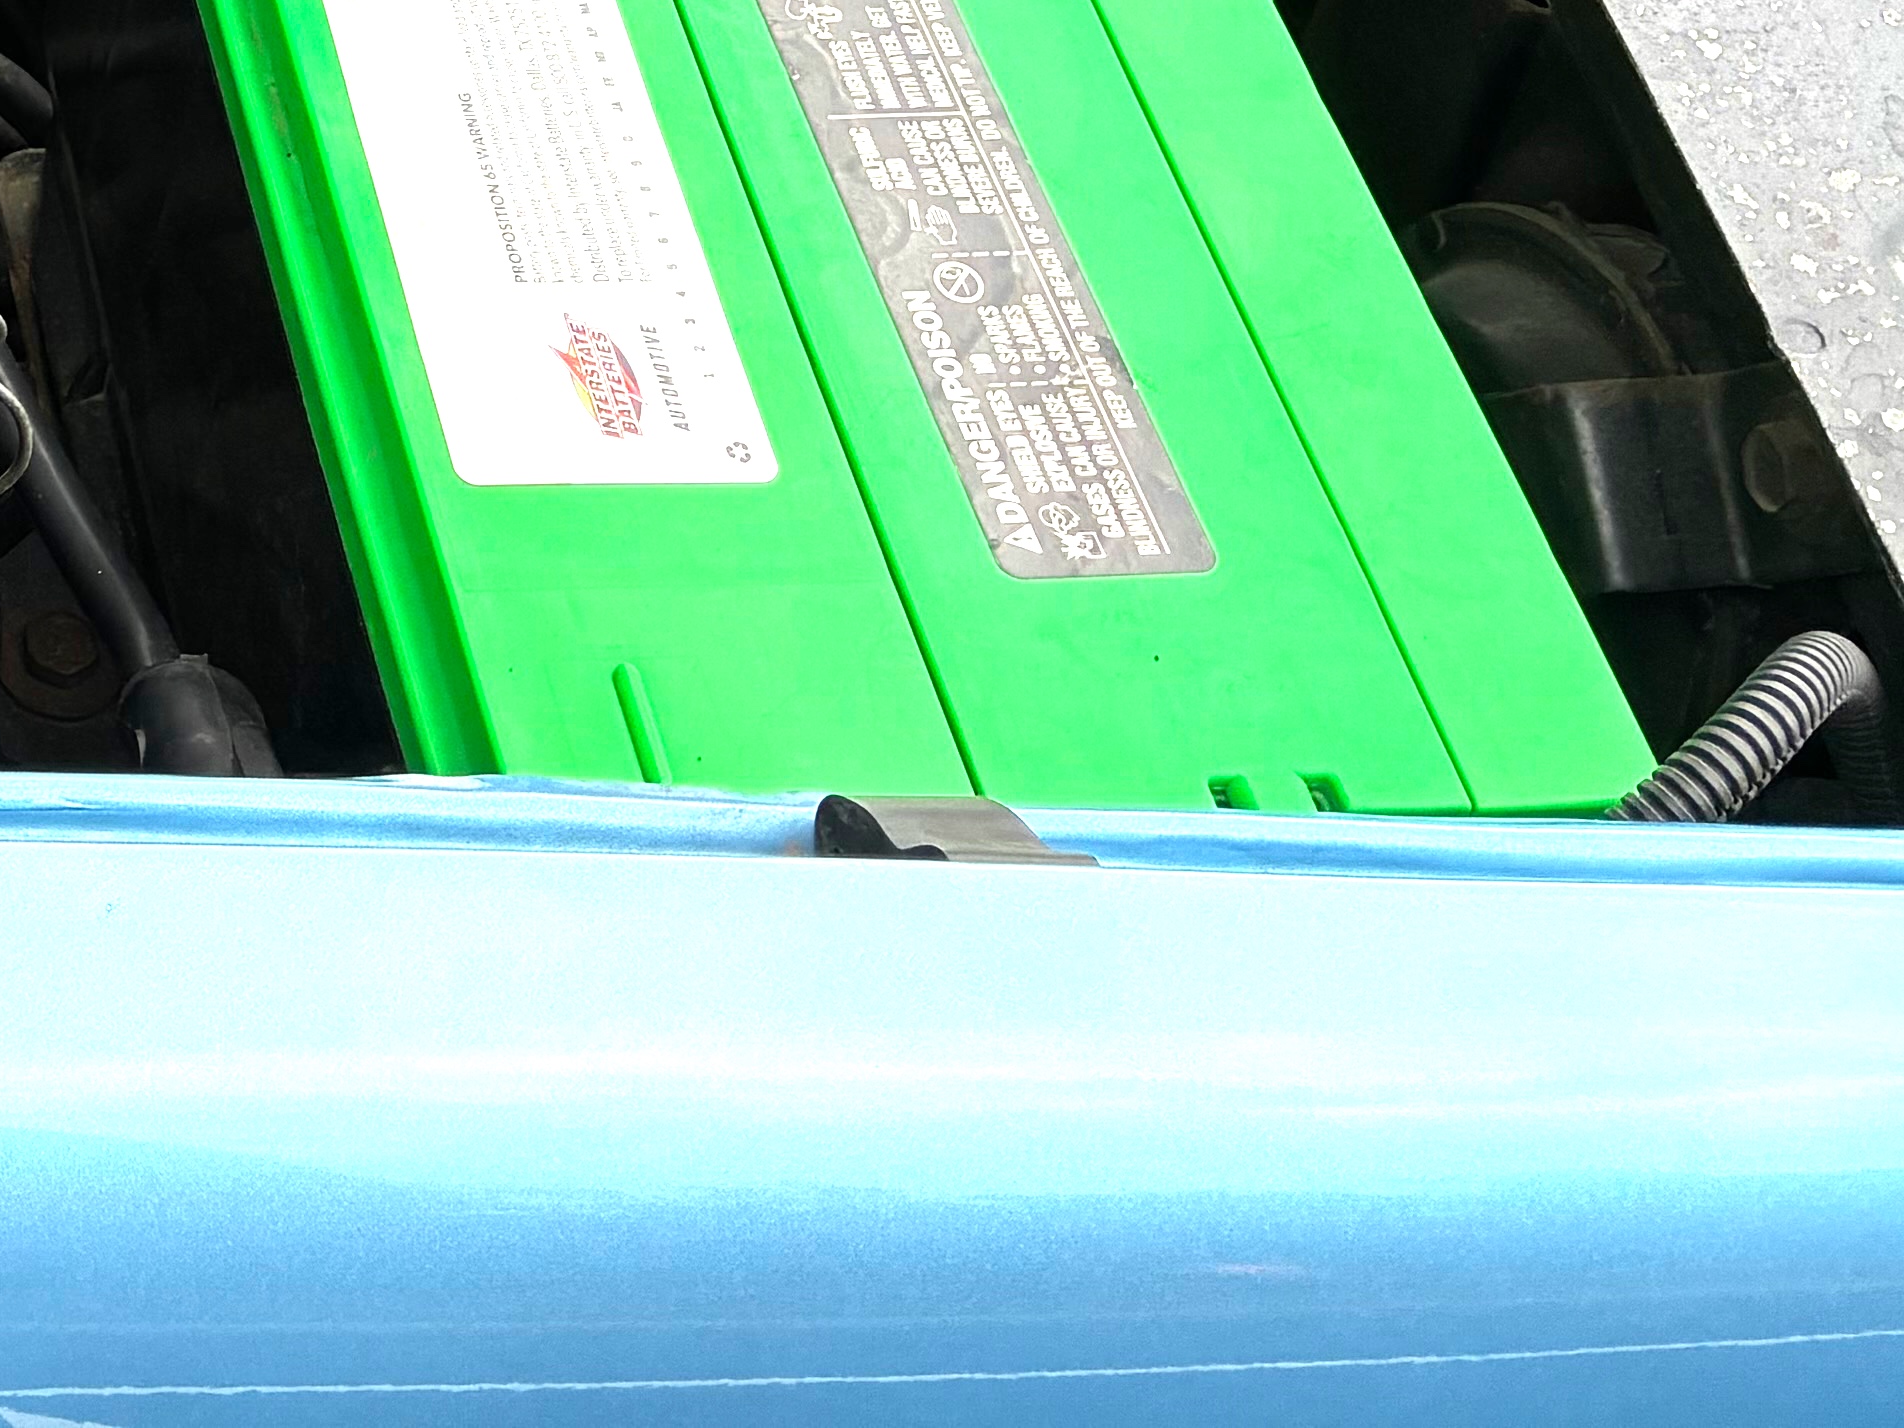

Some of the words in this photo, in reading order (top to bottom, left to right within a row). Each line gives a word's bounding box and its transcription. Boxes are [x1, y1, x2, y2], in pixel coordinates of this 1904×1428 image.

[828, 39, 858, 70] EYES
[899, 23, 931, 55] HELP
[930, 21, 962, 57] KEEP
[841, 71, 875, 110] FLUSH
[896, 75, 928, 108] WITH
[960, 88, 991, 117] NOT
[457, 91, 489, 160] WARNING
[897, 119, 934, 165] CAUSE
[920, 119, 946, 140] OR
[975, 118, 1002, 140] DO
[479, 163, 497, 180] 65
[917, 166, 948, 196] CAN
[929, 140, 980, 213] BLINDNESS
[962, 163, 1004, 214] SEVERE
[486, 183, 528, 283] PROPOSITION
[1023, 223, 1050, 244] OF
[1035, 247, 1075, 297] REACH
[977, 304, 1020, 363] SPARKS
[1001, 304, 1045, 362] FLAMES
[1022, 293, 1070, 361] SMOKING
[1059, 298, 1089, 329] THE
[1074, 330, 1100, 352] OF
[568, 321, 620, 438] INTERSTATE
[590, 330, 639, 434] BATTERIES
[638, 323, 690, 432] AUTOMOTIVE
[1084, 354, 1117, 387] OUT
[902, 290, 1027, 523] DANGER/POISON
[985, 388, 1022, 431] EYES
[1040, 392, 1081, 442] CAUSE
[1063, 386, 1107, 440] INJURY
[1102, 388, 1137, 428] KEEP
[1005, 434, 1049, 493] SHIELD
[1017, 403, 1076, 492] EXPLOSIVE
[1064, 444, 1097, 476] CAN
[1090, 442, 1119, 466] OR
[1081, 481, 1125, 538] GASES
[1102, 468, 1161, 555] BLINDNESS
